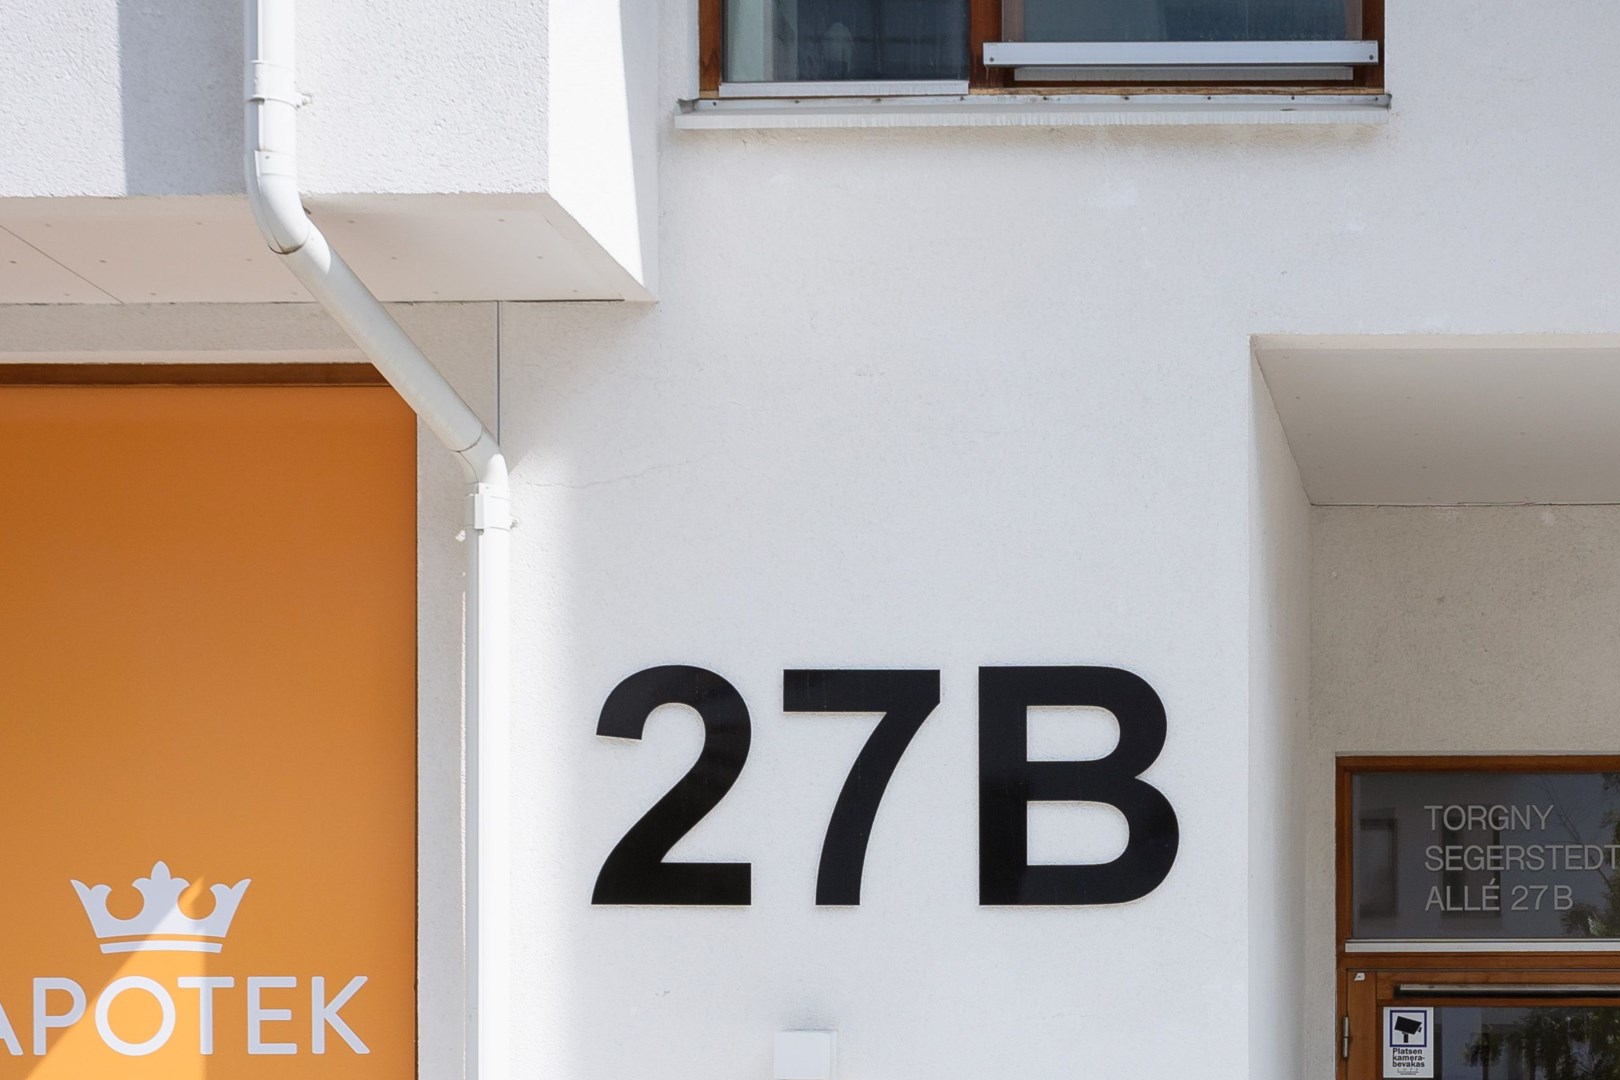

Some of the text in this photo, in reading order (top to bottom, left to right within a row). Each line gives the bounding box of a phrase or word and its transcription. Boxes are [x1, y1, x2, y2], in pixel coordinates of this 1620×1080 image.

[591, 664, 1180, 906] 27B
[1424, 804, 1554, 831] TORGNY
[1424, 878, 1574, 912] ALLÉ 27B
[1392, 1060, 1425, 1068] bevakas
